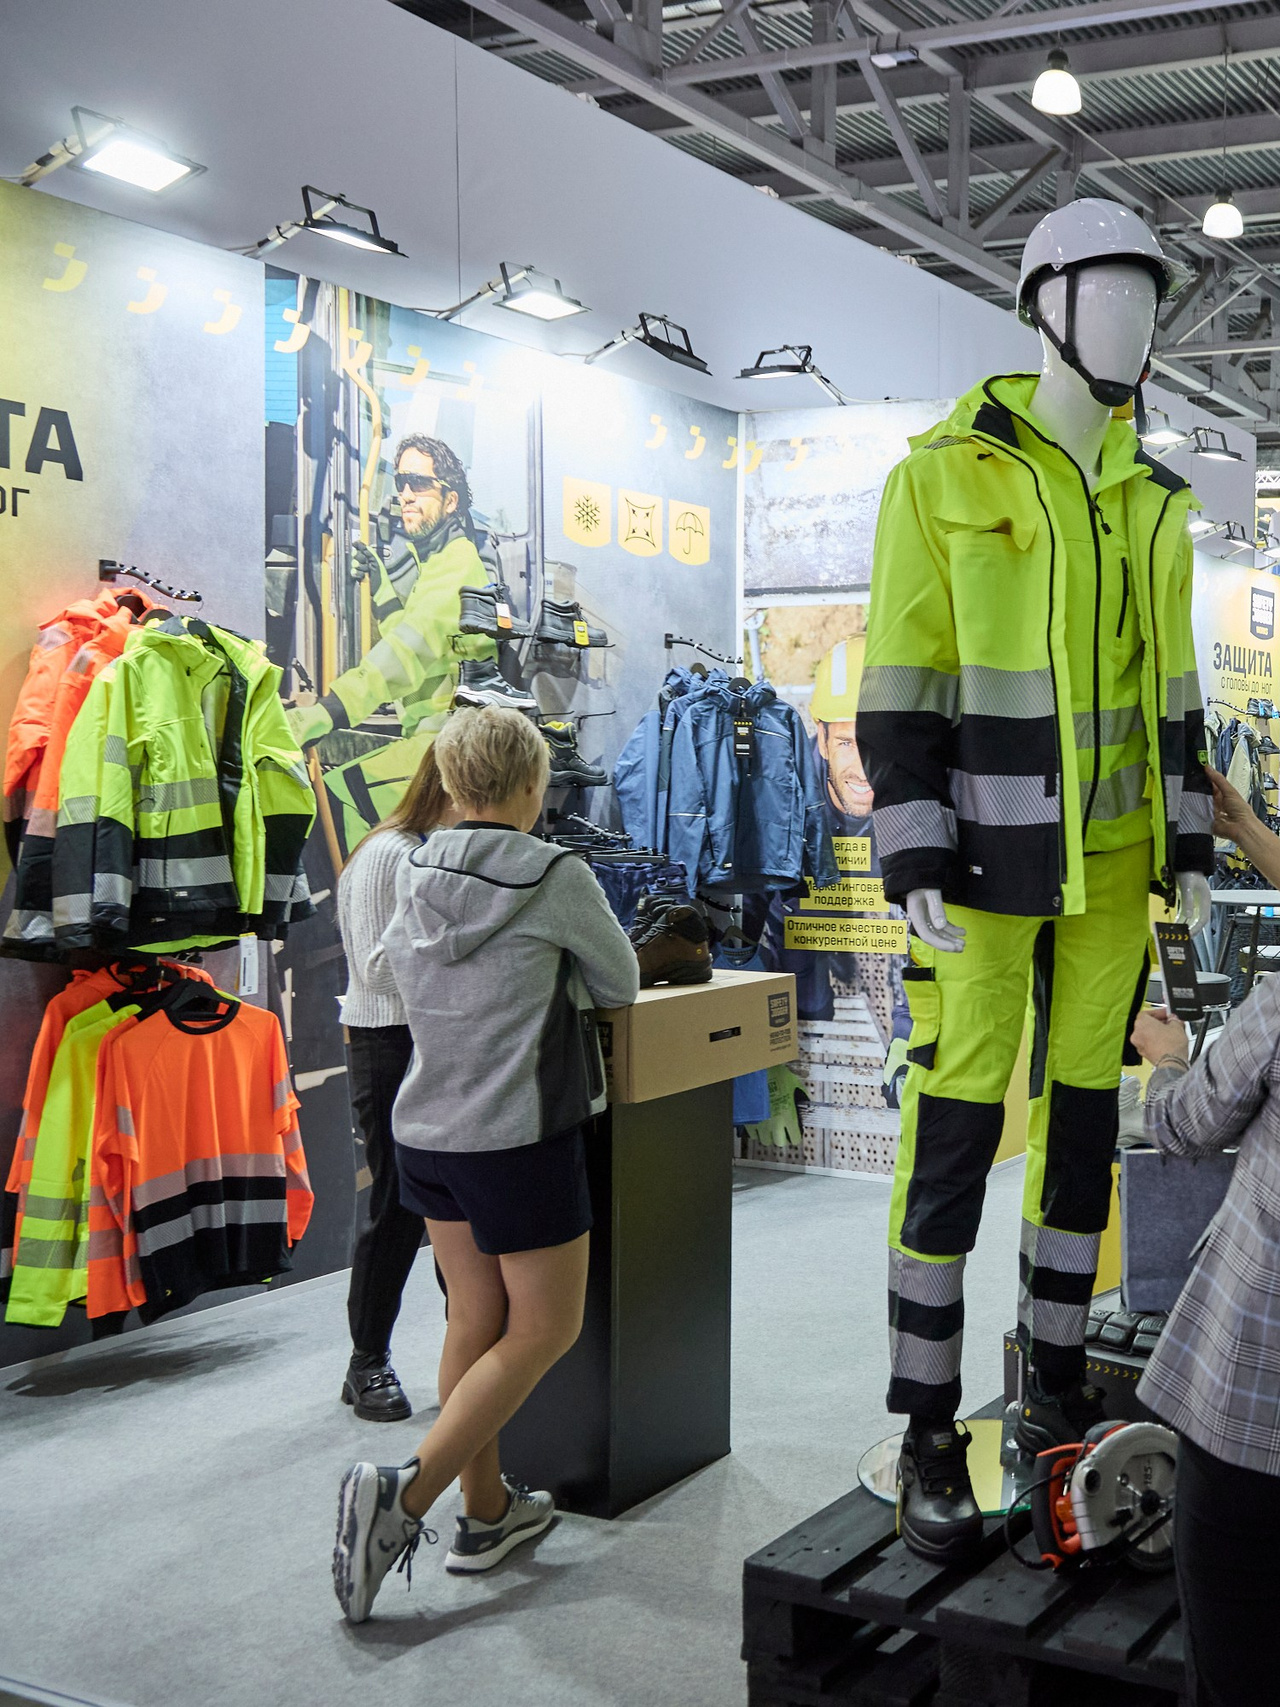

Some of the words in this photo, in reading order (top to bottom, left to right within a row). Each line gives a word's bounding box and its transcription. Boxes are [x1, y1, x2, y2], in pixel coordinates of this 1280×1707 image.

[1213, 642, 1272, 678] ЗАЩИТА
[834, 842, 858, 852] егда
[835, 856, 867, 865] личии
[814, 896, 875, 907] поддержка
[787, 920, 837, 932] Отличное
[839, 924, 888, 934] качество
[891, 926, 904, 934] по
[793, 935, 868, 947] конкурентной
[871, 938, 897, 948] цене
